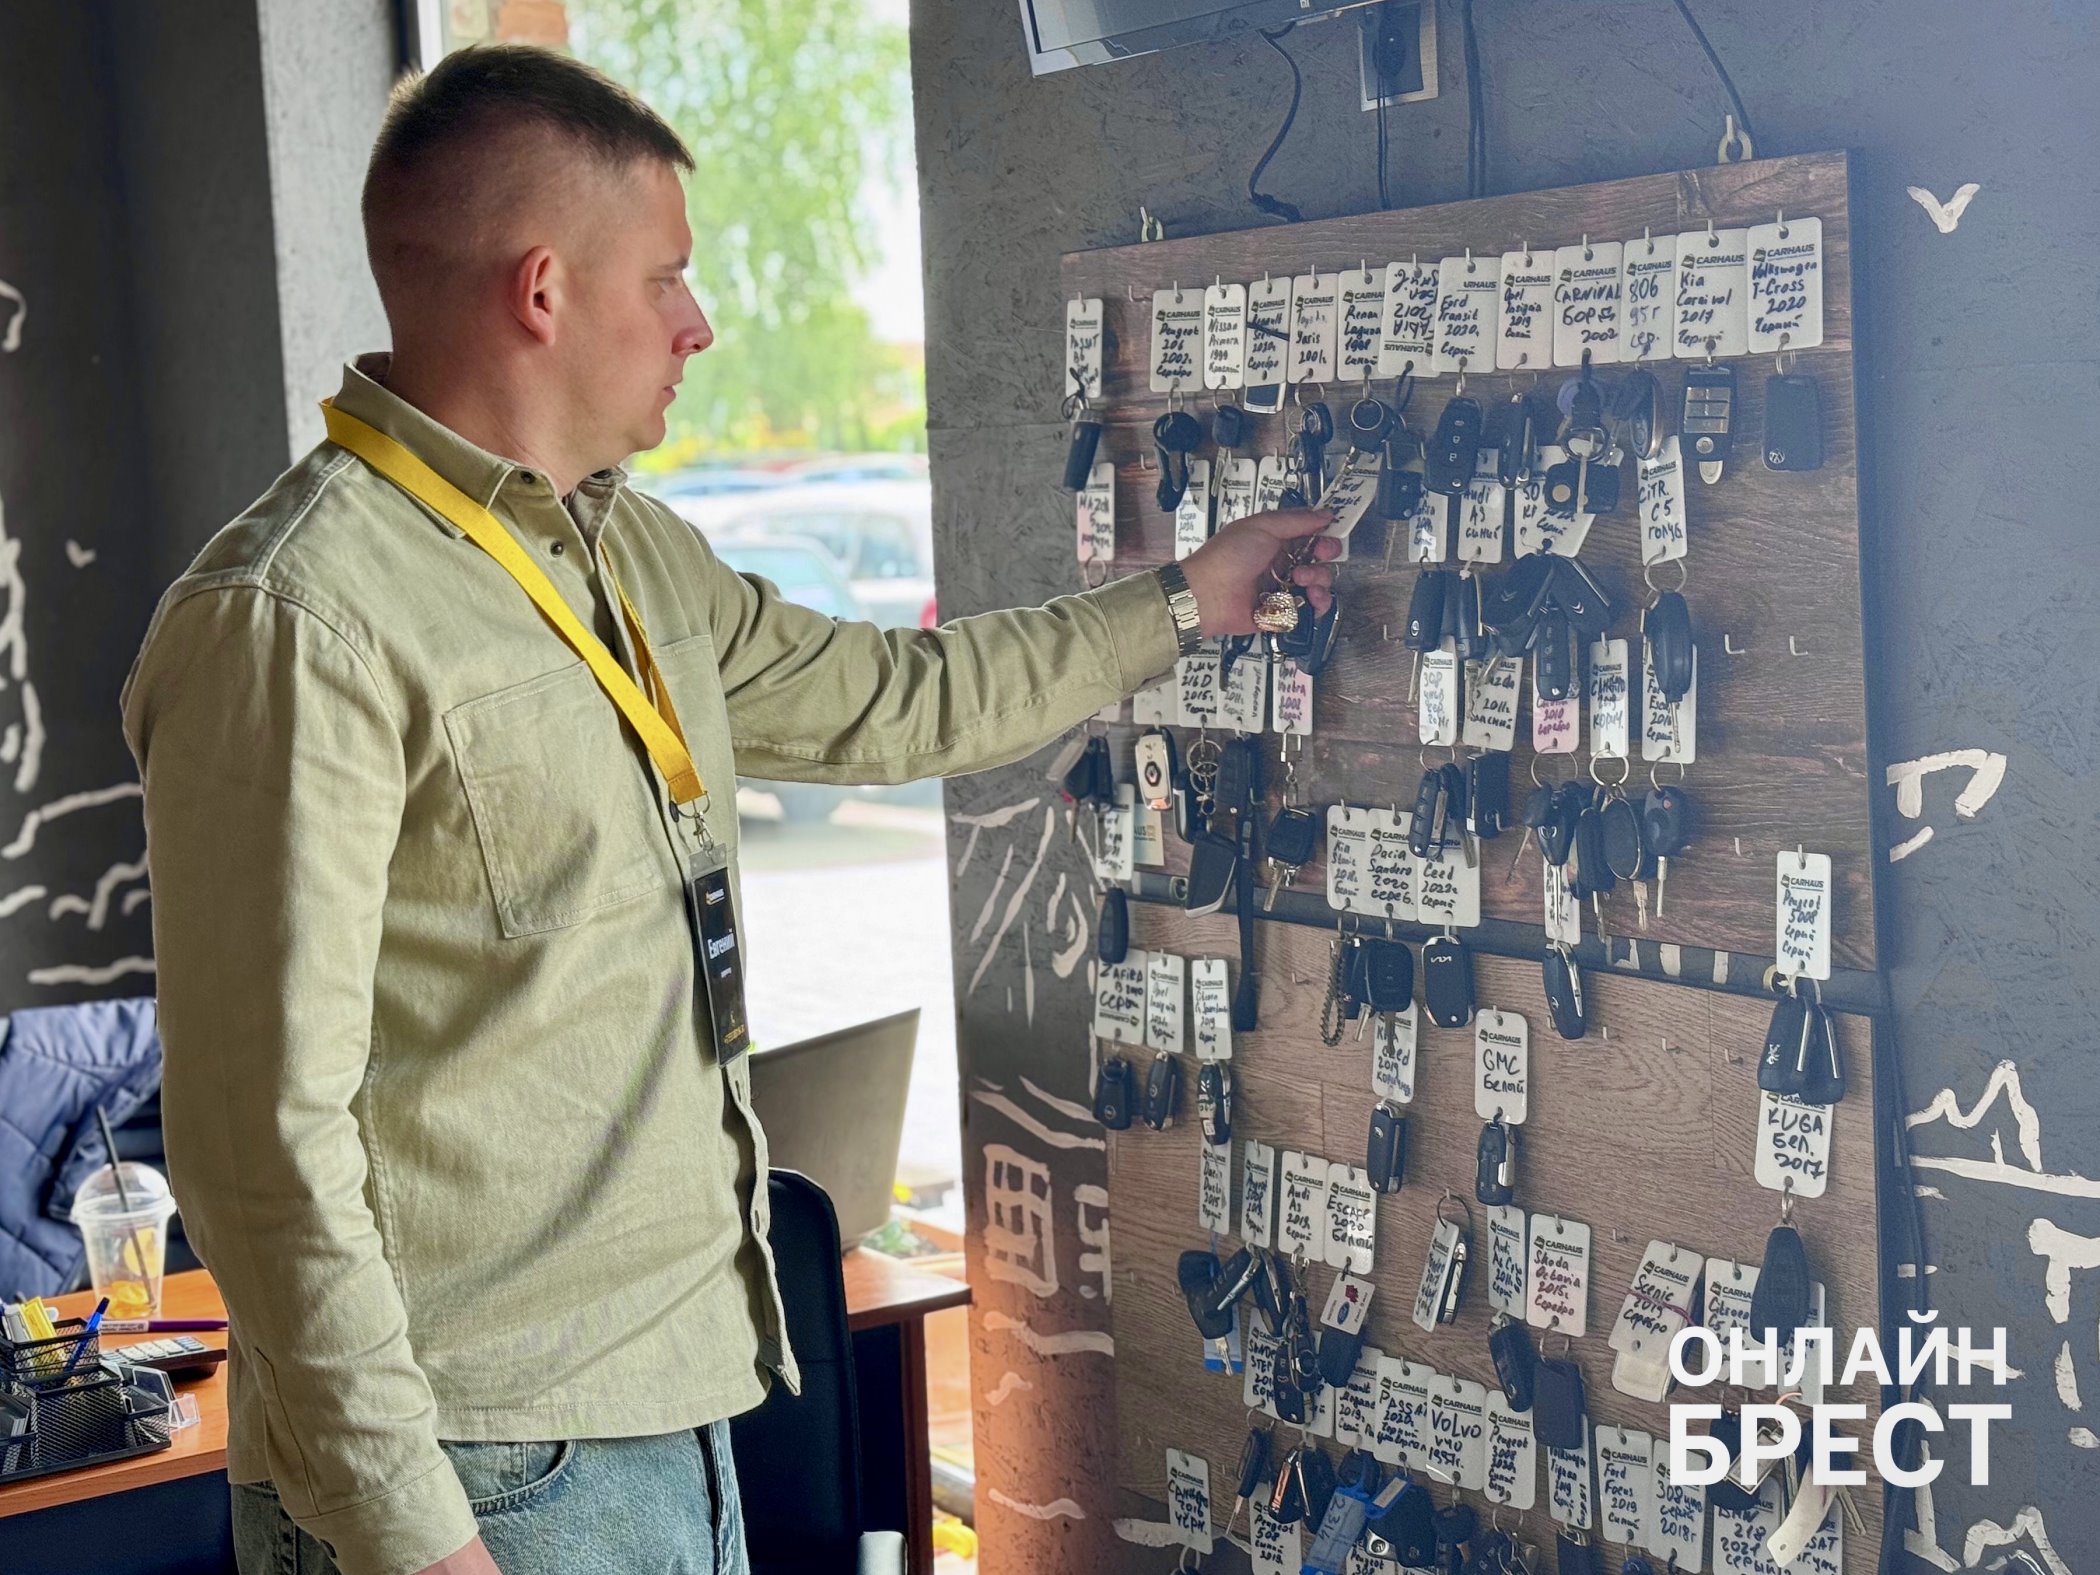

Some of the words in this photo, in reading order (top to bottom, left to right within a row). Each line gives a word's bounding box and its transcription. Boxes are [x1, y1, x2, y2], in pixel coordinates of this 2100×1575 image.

[1767, 244, 1815, 257] CARHAUS
[1637, 261, 1672, 272] CARHAUS
[1696, 255, 1745, 264] CARHAUS
[1515, 275, 1552, 283] CARHAUS
[1573, 267, 1617, 277] CARHAUS
[1680, 271, 1705, 289] Kia
[1629, 275, 1659, 303] 806
[1441, 294, 1469, 310] Ford
[1766, 296, 1806, 315] 2020
[1680, 309, 1714, 324] 2017
[1159, 323, 1200, 339] Peugeot
[1581, 328, 1618, 344] 2002
[1370, 844, 1407, 861] Dacia
[1367, 858, 1412, 876] Sandero
[1371, 875, 1409, 890] 2020
[1791, 878, 1824, 889] CARHAUS
[1788, 909, 1818, 925] 5008
[1488, 1032, 1522, 1045] CARHAUS
[1482, 1048, 1521, 1076] GMC
[1768, 1107, 1824, 1136] KUGA
[1293, 1174, 1324, 1187] CARHAUS
[1339, 1185, 1371, 1199] CARHAUS
[1545, 1239, 1585, 1254] CARHAUS
[1534, 1250, 1569, 1271] Skoda
[1535, 1267, 1581, 1288] Octavia
[1653, 1265, 1690, 1284] CARHAUS
[1634, 1273, 1675, 1302] Scenic
[1722, 1285, 1752, 1300] CARHA
[1443, 1398, 1482, 1414] CARHAUS
[1497, 1414, 1531, 1429] CARHAUS
[1611, 1450, 1648, 1464] CARHAUS
[1603, 1462, 1627, 1479] Ford
[1604, 1479, 1634, 1497] Focus
[1610, 1498, 1638, 1514] 2019
[1254, 1514, 1295, 1535] Peugeot
